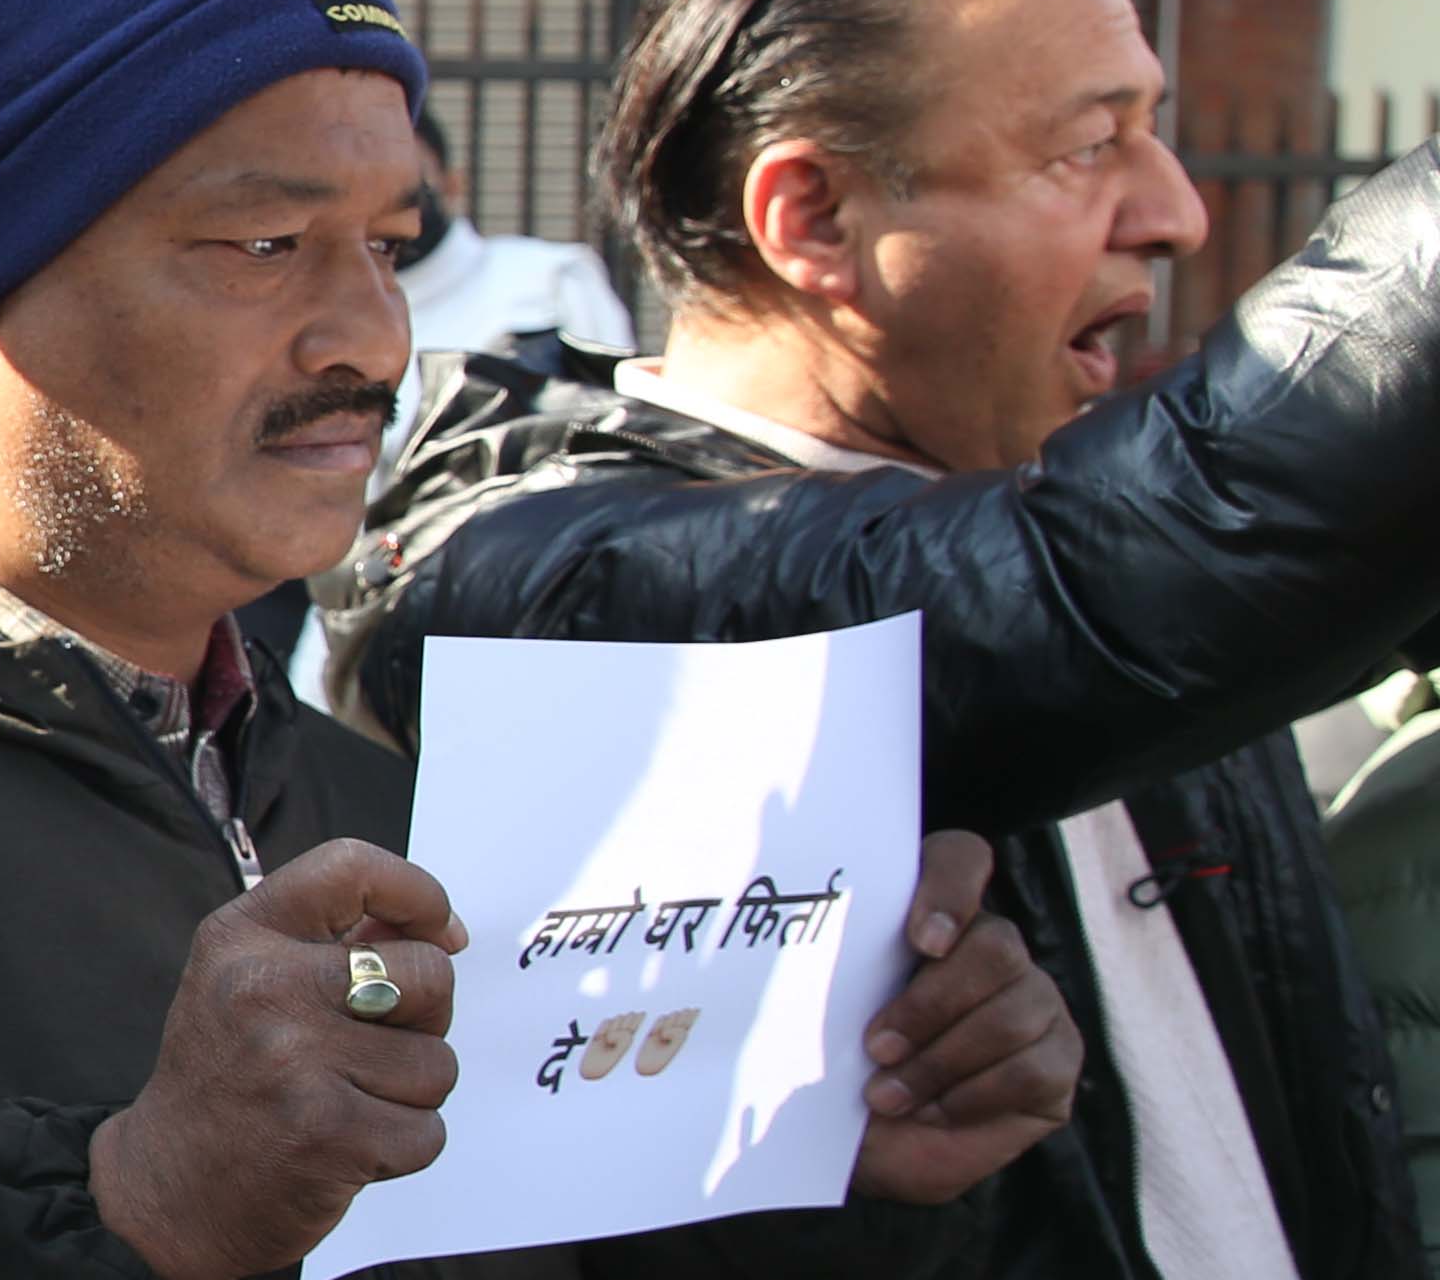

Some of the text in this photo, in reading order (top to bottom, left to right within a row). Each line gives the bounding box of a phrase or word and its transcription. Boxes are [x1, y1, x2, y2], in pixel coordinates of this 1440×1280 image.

[644, 897, 723, 954] घर
[718, 867, 843, 952] फिर्ता
[535, 1018, 589, 1096] दे
